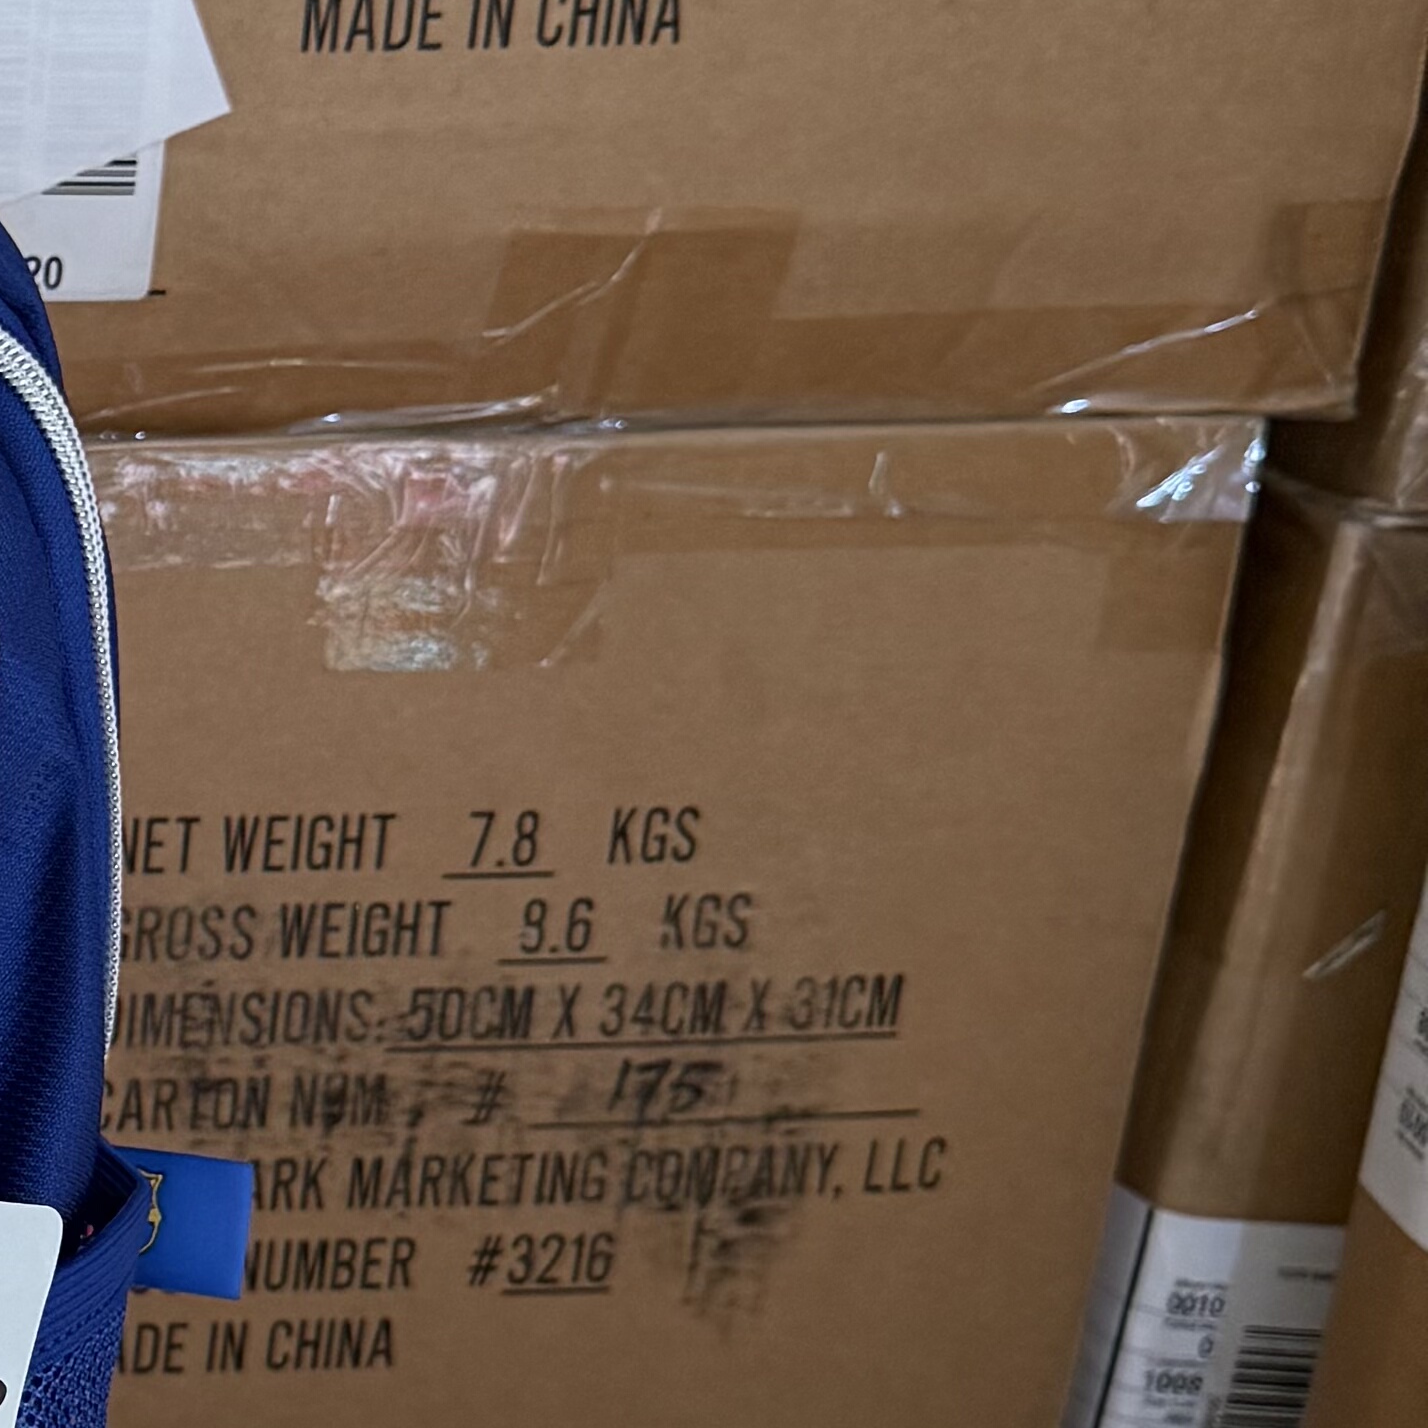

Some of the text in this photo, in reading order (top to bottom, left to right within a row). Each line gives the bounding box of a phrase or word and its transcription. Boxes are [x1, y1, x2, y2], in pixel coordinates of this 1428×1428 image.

[120, 806, 701, 874] NET WEIGHT 7.8 KGS
[279, 900, 452, 960] WEIGHT
[660, 893, 755, 950] KGS
[403, 986, 535, 1042] 50CM
[549, 983, 581, 1040] X
[600, 980, 727, 1039] 34CM
[742, 976, 772, 1033] X
[787, 973, 904, 1032] 31CM
[347, 1154, 606, 1209] MARKETING
[862, 1138, 949, 1196] LLC
[468, 1232, 615, 1286] #3216
[206, 1321, 249, 1372] IN
[265, 1319, 396, 1371] CHINA
